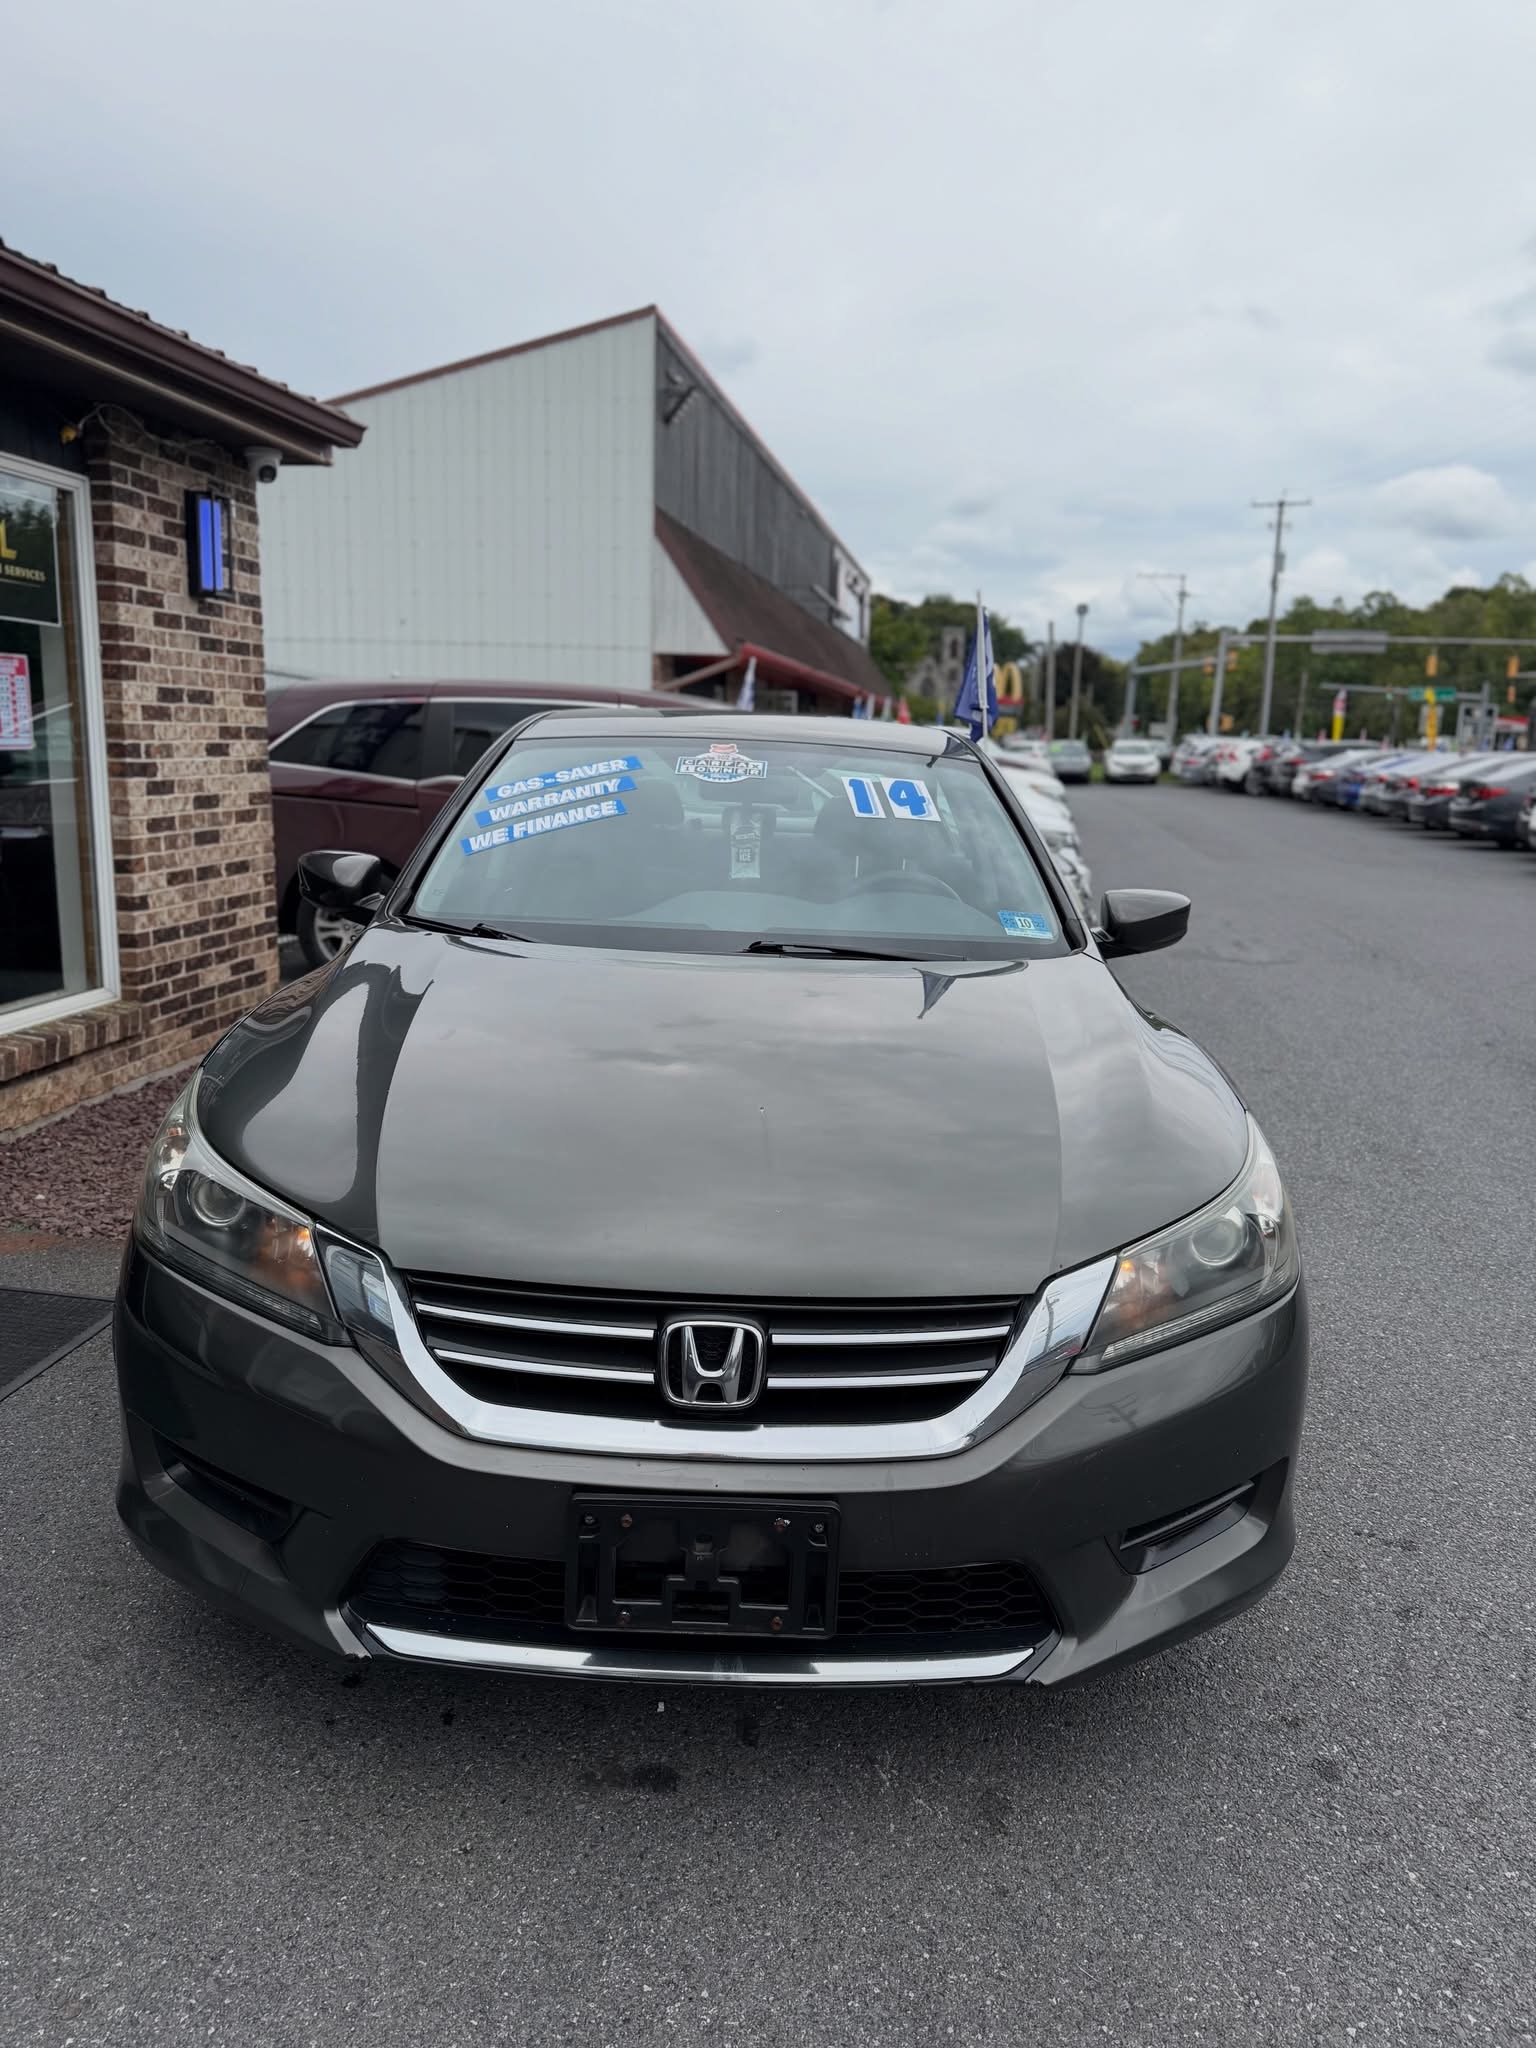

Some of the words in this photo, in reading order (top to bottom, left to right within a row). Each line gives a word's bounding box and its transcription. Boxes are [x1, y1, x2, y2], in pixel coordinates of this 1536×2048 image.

[4, 564, 46, 582] SERVICES
[683, 759, 760, 769] CARFAX
[696, 766, 760, 775] OWNER
[497, 759, 629, 798] GAS-SAVER
[489, 778, 621, 822] WARRANTY
[849, 778, 927, 817] 14
[469, 827, 510, 851] WE
[513, 800, 618, 839] FINANCE
[1017, 918, 1032, 929] 10
